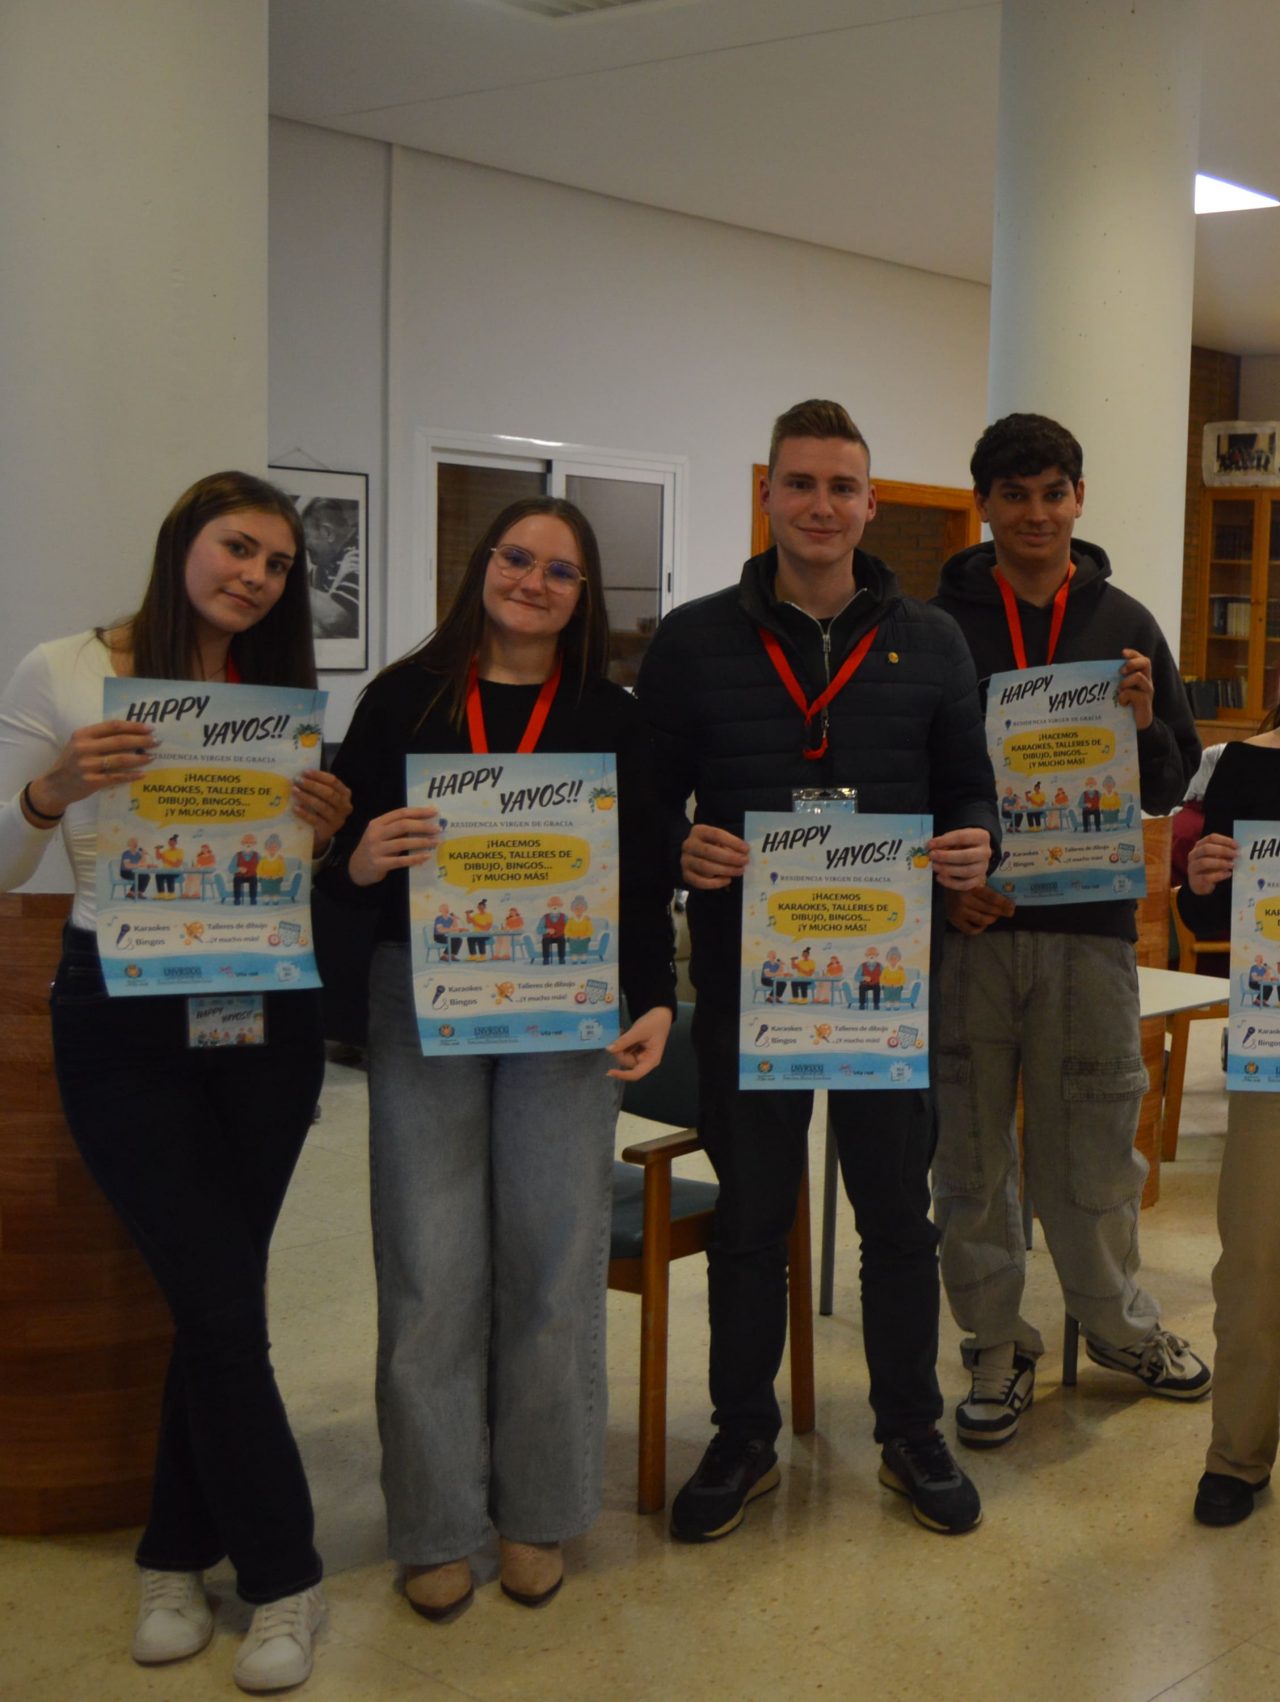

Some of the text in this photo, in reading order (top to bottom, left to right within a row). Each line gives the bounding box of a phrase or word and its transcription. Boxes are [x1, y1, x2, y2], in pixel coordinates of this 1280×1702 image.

[1000, 674, 1054, 705] HAPPY
[1048, 681, 1111, 713] YAYOS!!
[125, 695, 211, 723] HAPPY
[202, 714, 291, 746] YAYOS!!
[184, 774, 241, 783] ¡HACEMOS
[427, 766, 504, 799] HAPPY
[142, 784, 271, 797] KARAOKES, TALLERES DE
[500, 779, 583, 814] YAYOS!!
[157, 797, 251, 807] DIBUJO, BINGOS...
[165, 808, 246, 818] ¡Y MUCHO MÁS!
[487, 838, 541, 849] ¡HACEMOS
[761, 824, 832, 853] HAPPY
[449, 850, 572, 863] KARAOKES, TALLERES DE
[826, 839, 902, 870] YAYOS!!
[464, 861, 552, 873] DIBUJO, BINGOS...
[472, 871, 549, 884] ¡Y MUCHO MÁS!
[812, 893, 861, 901] ¡HACEMOS
[778, 902, 888, 913] KARAOKES, TALLERES DE
[791, 913, 871, 923] DIBUJO, BINGOS...
[798, 923, 867, 933] ¡Y MUCHO MÁS!
